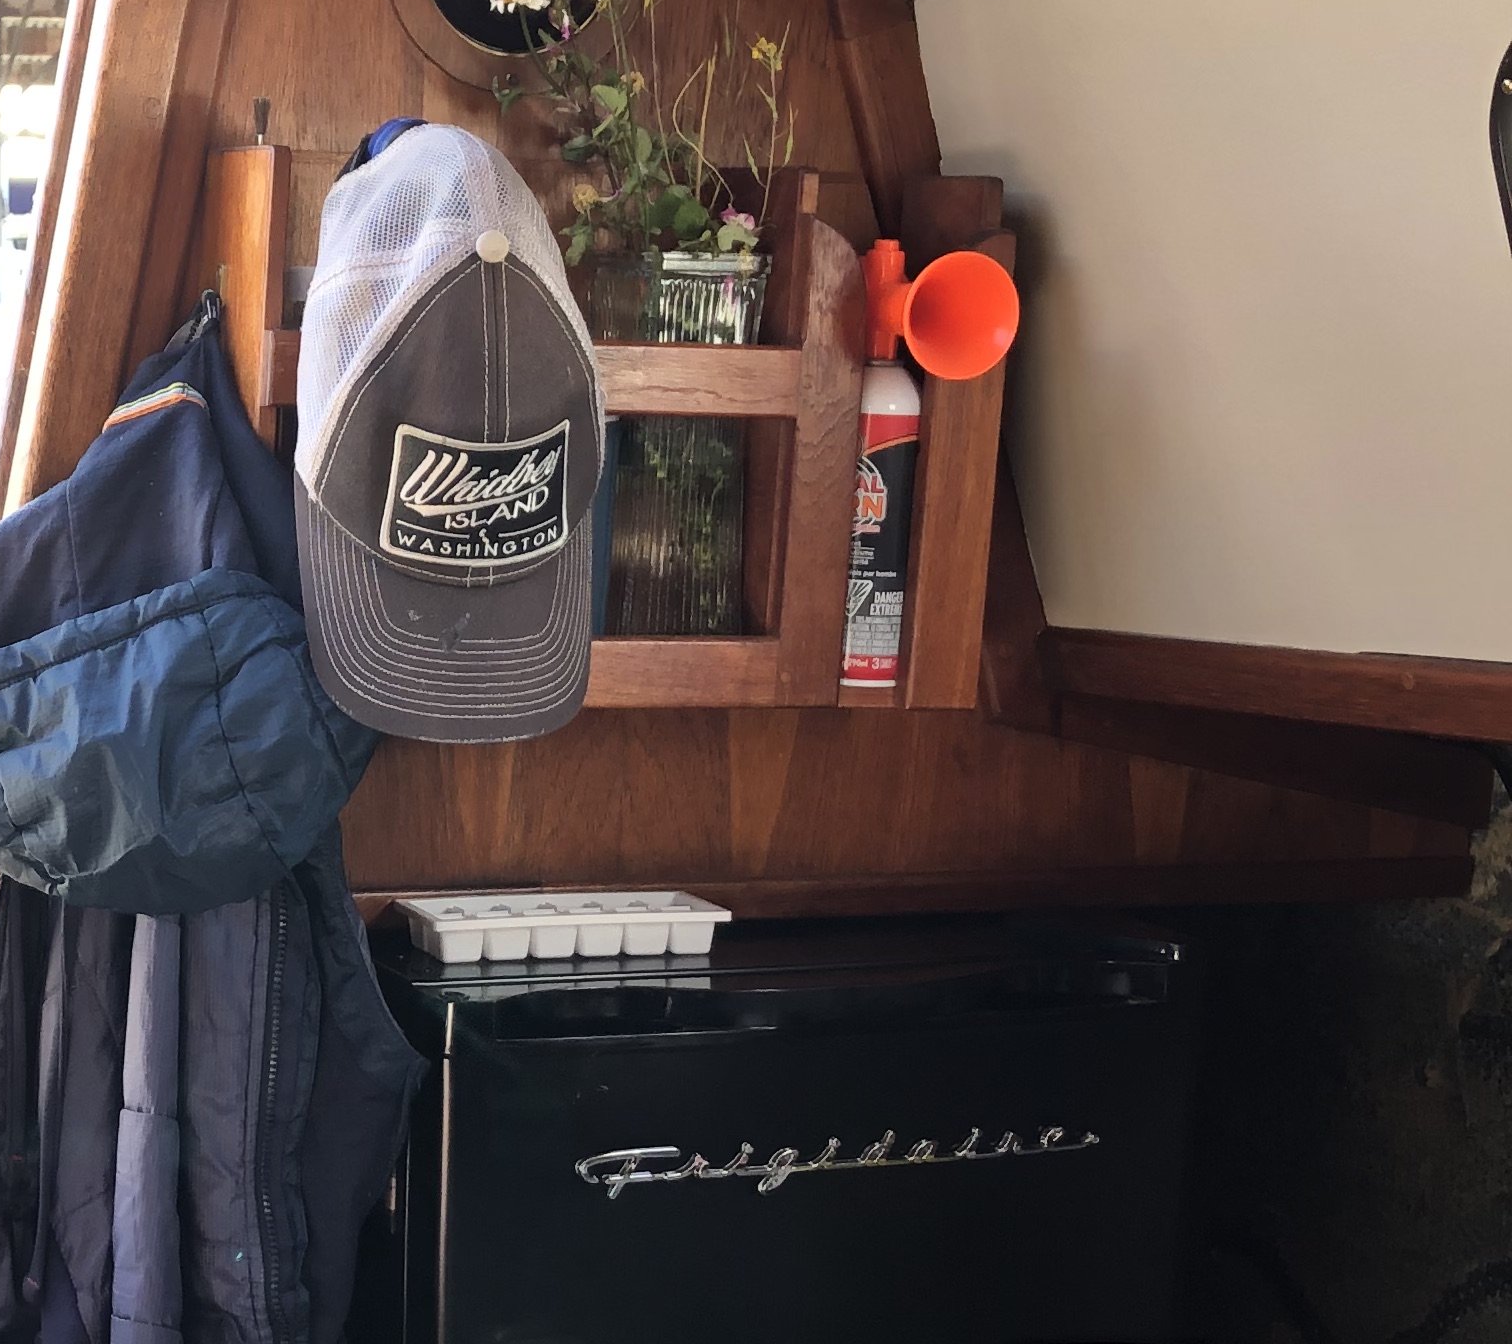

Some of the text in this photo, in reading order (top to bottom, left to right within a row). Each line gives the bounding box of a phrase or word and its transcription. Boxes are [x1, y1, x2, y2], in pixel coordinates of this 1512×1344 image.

[445, 486, 549, 530] ISLAND
[397, 525, 558, 557] WASHINGTON
[574, 1126, 1101, 1199] Frigidaire
